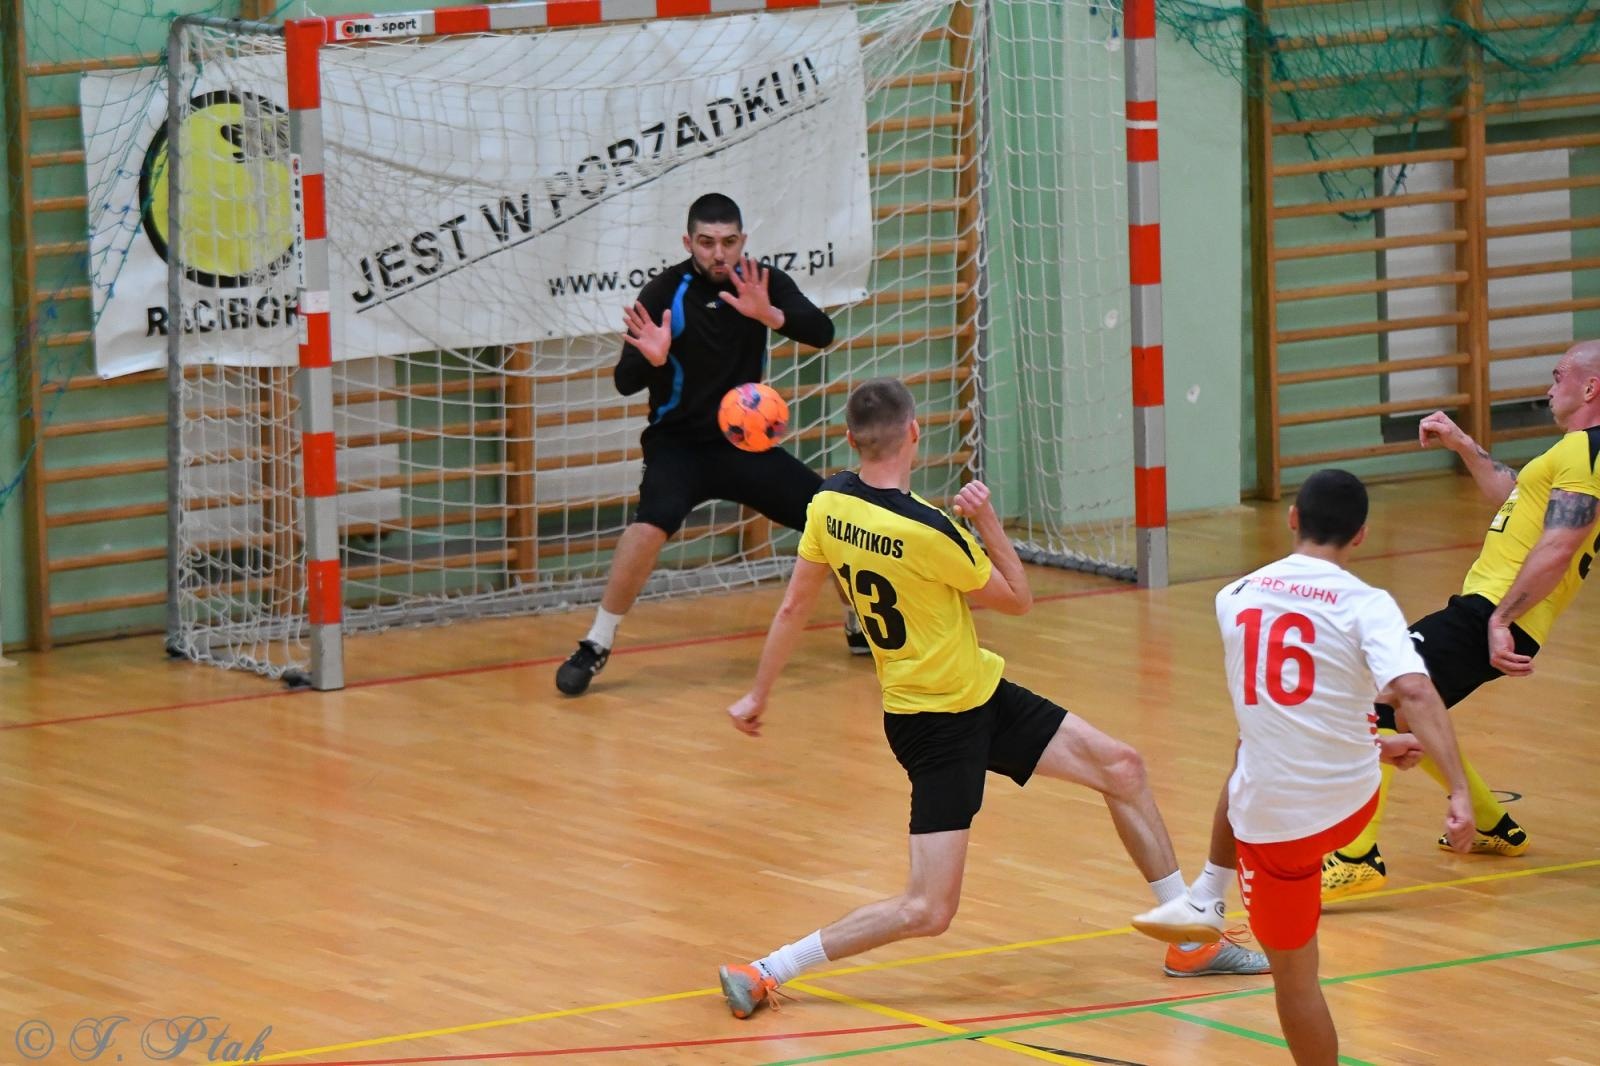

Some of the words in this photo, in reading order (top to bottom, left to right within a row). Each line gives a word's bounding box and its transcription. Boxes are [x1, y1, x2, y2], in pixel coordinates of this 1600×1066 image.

[382, 18, 417, 34] sport
[351, 213, 468, 304] JEST
[480, 193, 532, 243] W
[826, 514, 905, 559] GALAKTIKOS
[836, 562, 908, 651] 13
[1289, 583, 1339, 606] KUHN
[1235, 607, 1317, 707] 16
